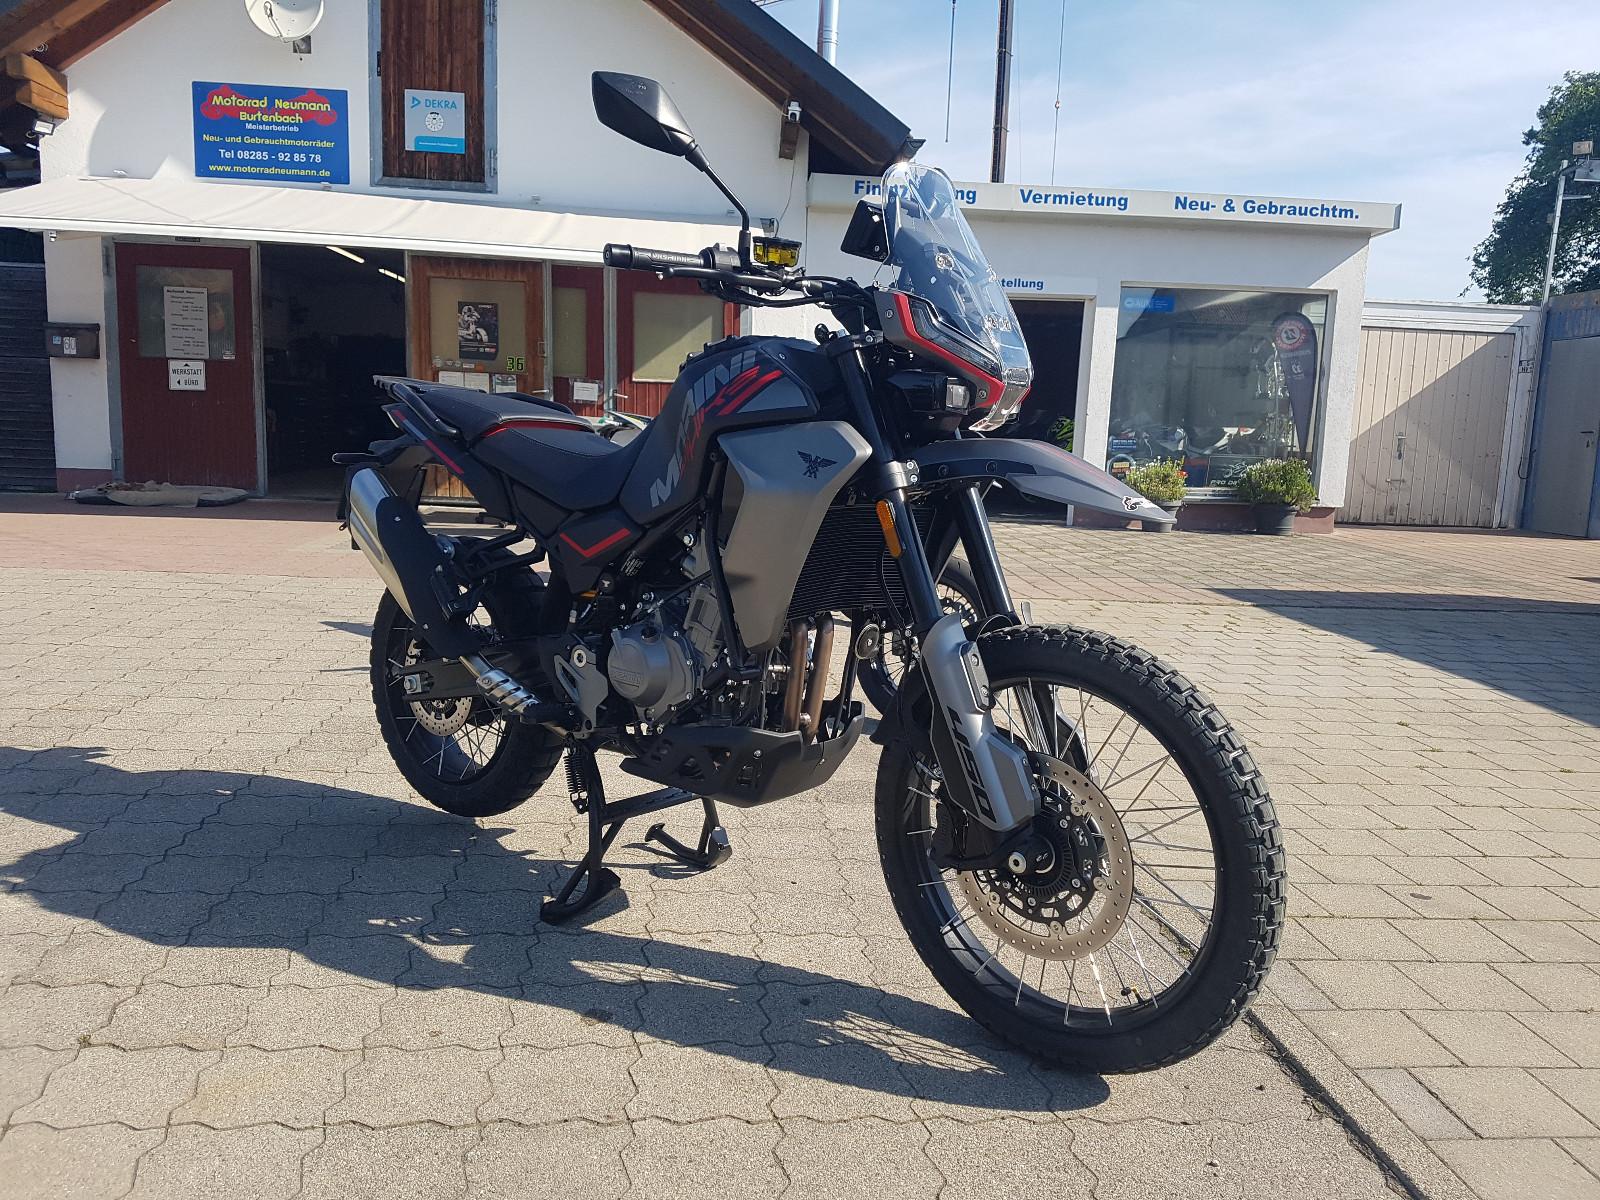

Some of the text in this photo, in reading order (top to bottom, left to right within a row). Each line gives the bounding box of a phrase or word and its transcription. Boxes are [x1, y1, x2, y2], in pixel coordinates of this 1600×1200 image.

[212, 95, 331, 111] Motorrad Neumann
[424, 98, 457, 109] DEKRA
[239, 111, 303, 123] Burtenbach
[245, 123, 299, 132] Meisterbetrieb
[203, 134, 223, 142] Neu-
[244, 136, 335, 148] Gebrauchtmotorräder
[219, 149, 234, 159] Tel
[237, 150, 269, 160] 08285
[278, 152, 291, 161] 92
[293, 153, 306, 162] 85
[309, 154, 322, 163] 78
[209, 164, 331, 177] www.motorradneumann.de
[1020, 189, 1129, 211] Vermietung
[1174, 196, 1360, 219] Neu- & Gebrauchtm.
[1000, 278, 1044, 291] tellung
[506, 356, 525, 372] 36
[171, 368, 202, 376] WERKSTATT
[947, 705, 997, 824] 450
